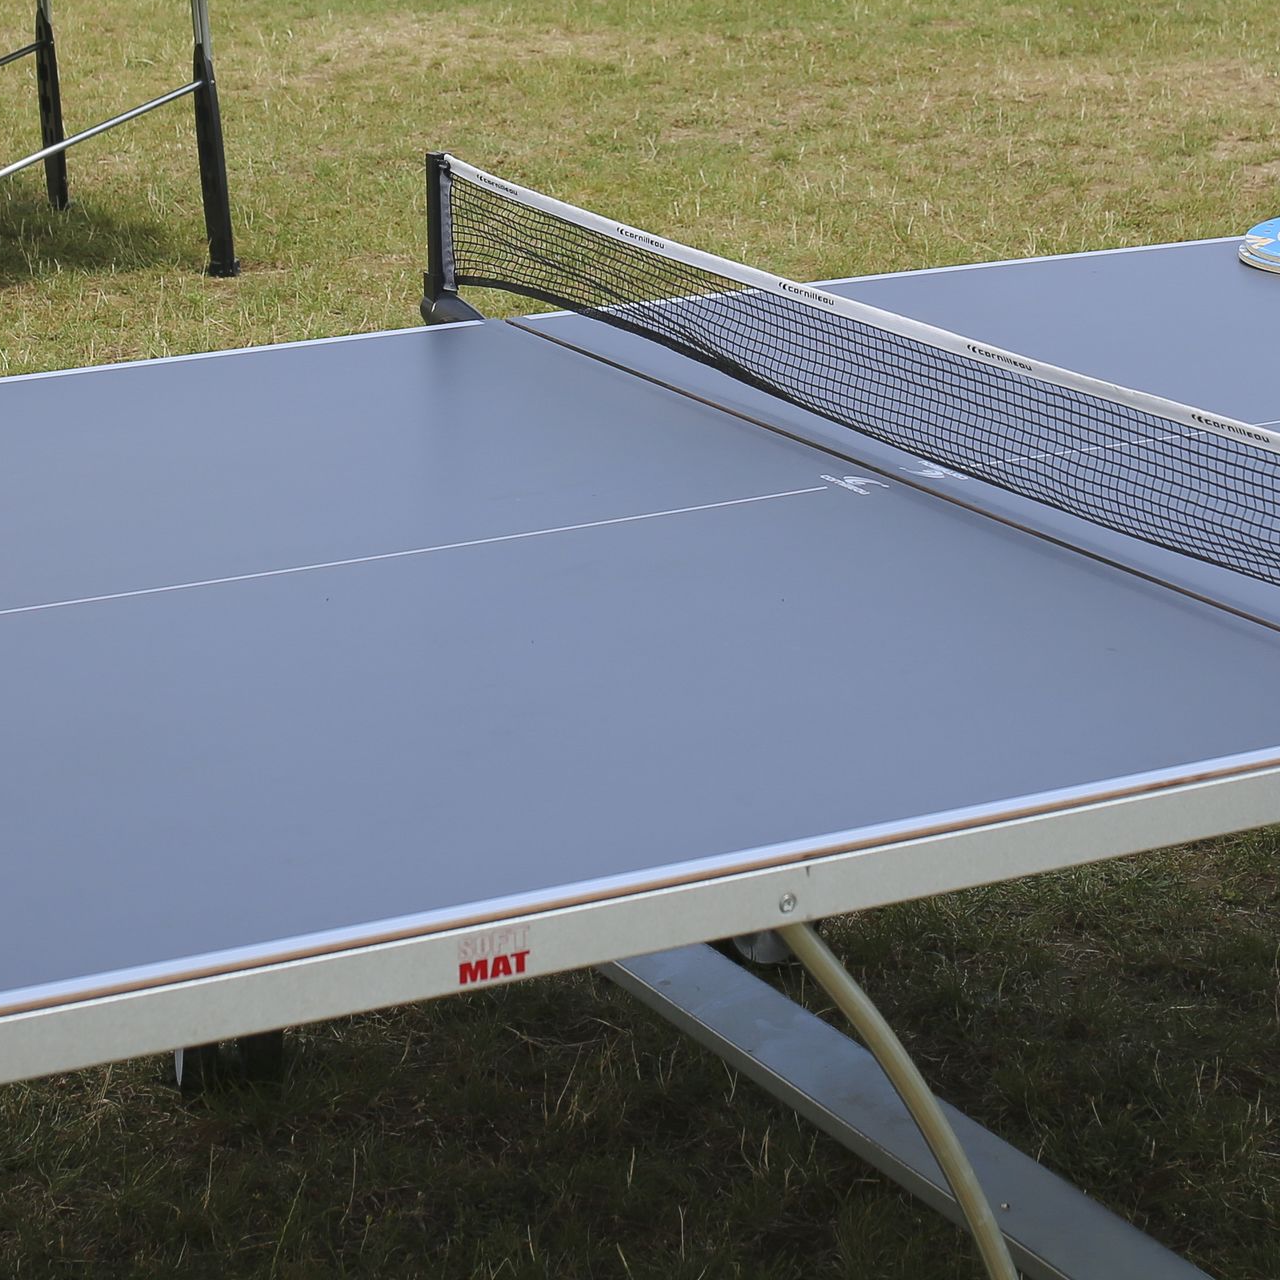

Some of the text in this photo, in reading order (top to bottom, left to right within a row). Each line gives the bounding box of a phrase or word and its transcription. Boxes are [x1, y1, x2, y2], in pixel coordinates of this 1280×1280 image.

[624, 230, 666, 249] cornilleau
[787, 285, 835, 306] cornilleau
[977, 348, 1033, 372] cornilleau
[1203, 418, 1271, 444] cornilleau
[458, 950, 530, 985] MAT
